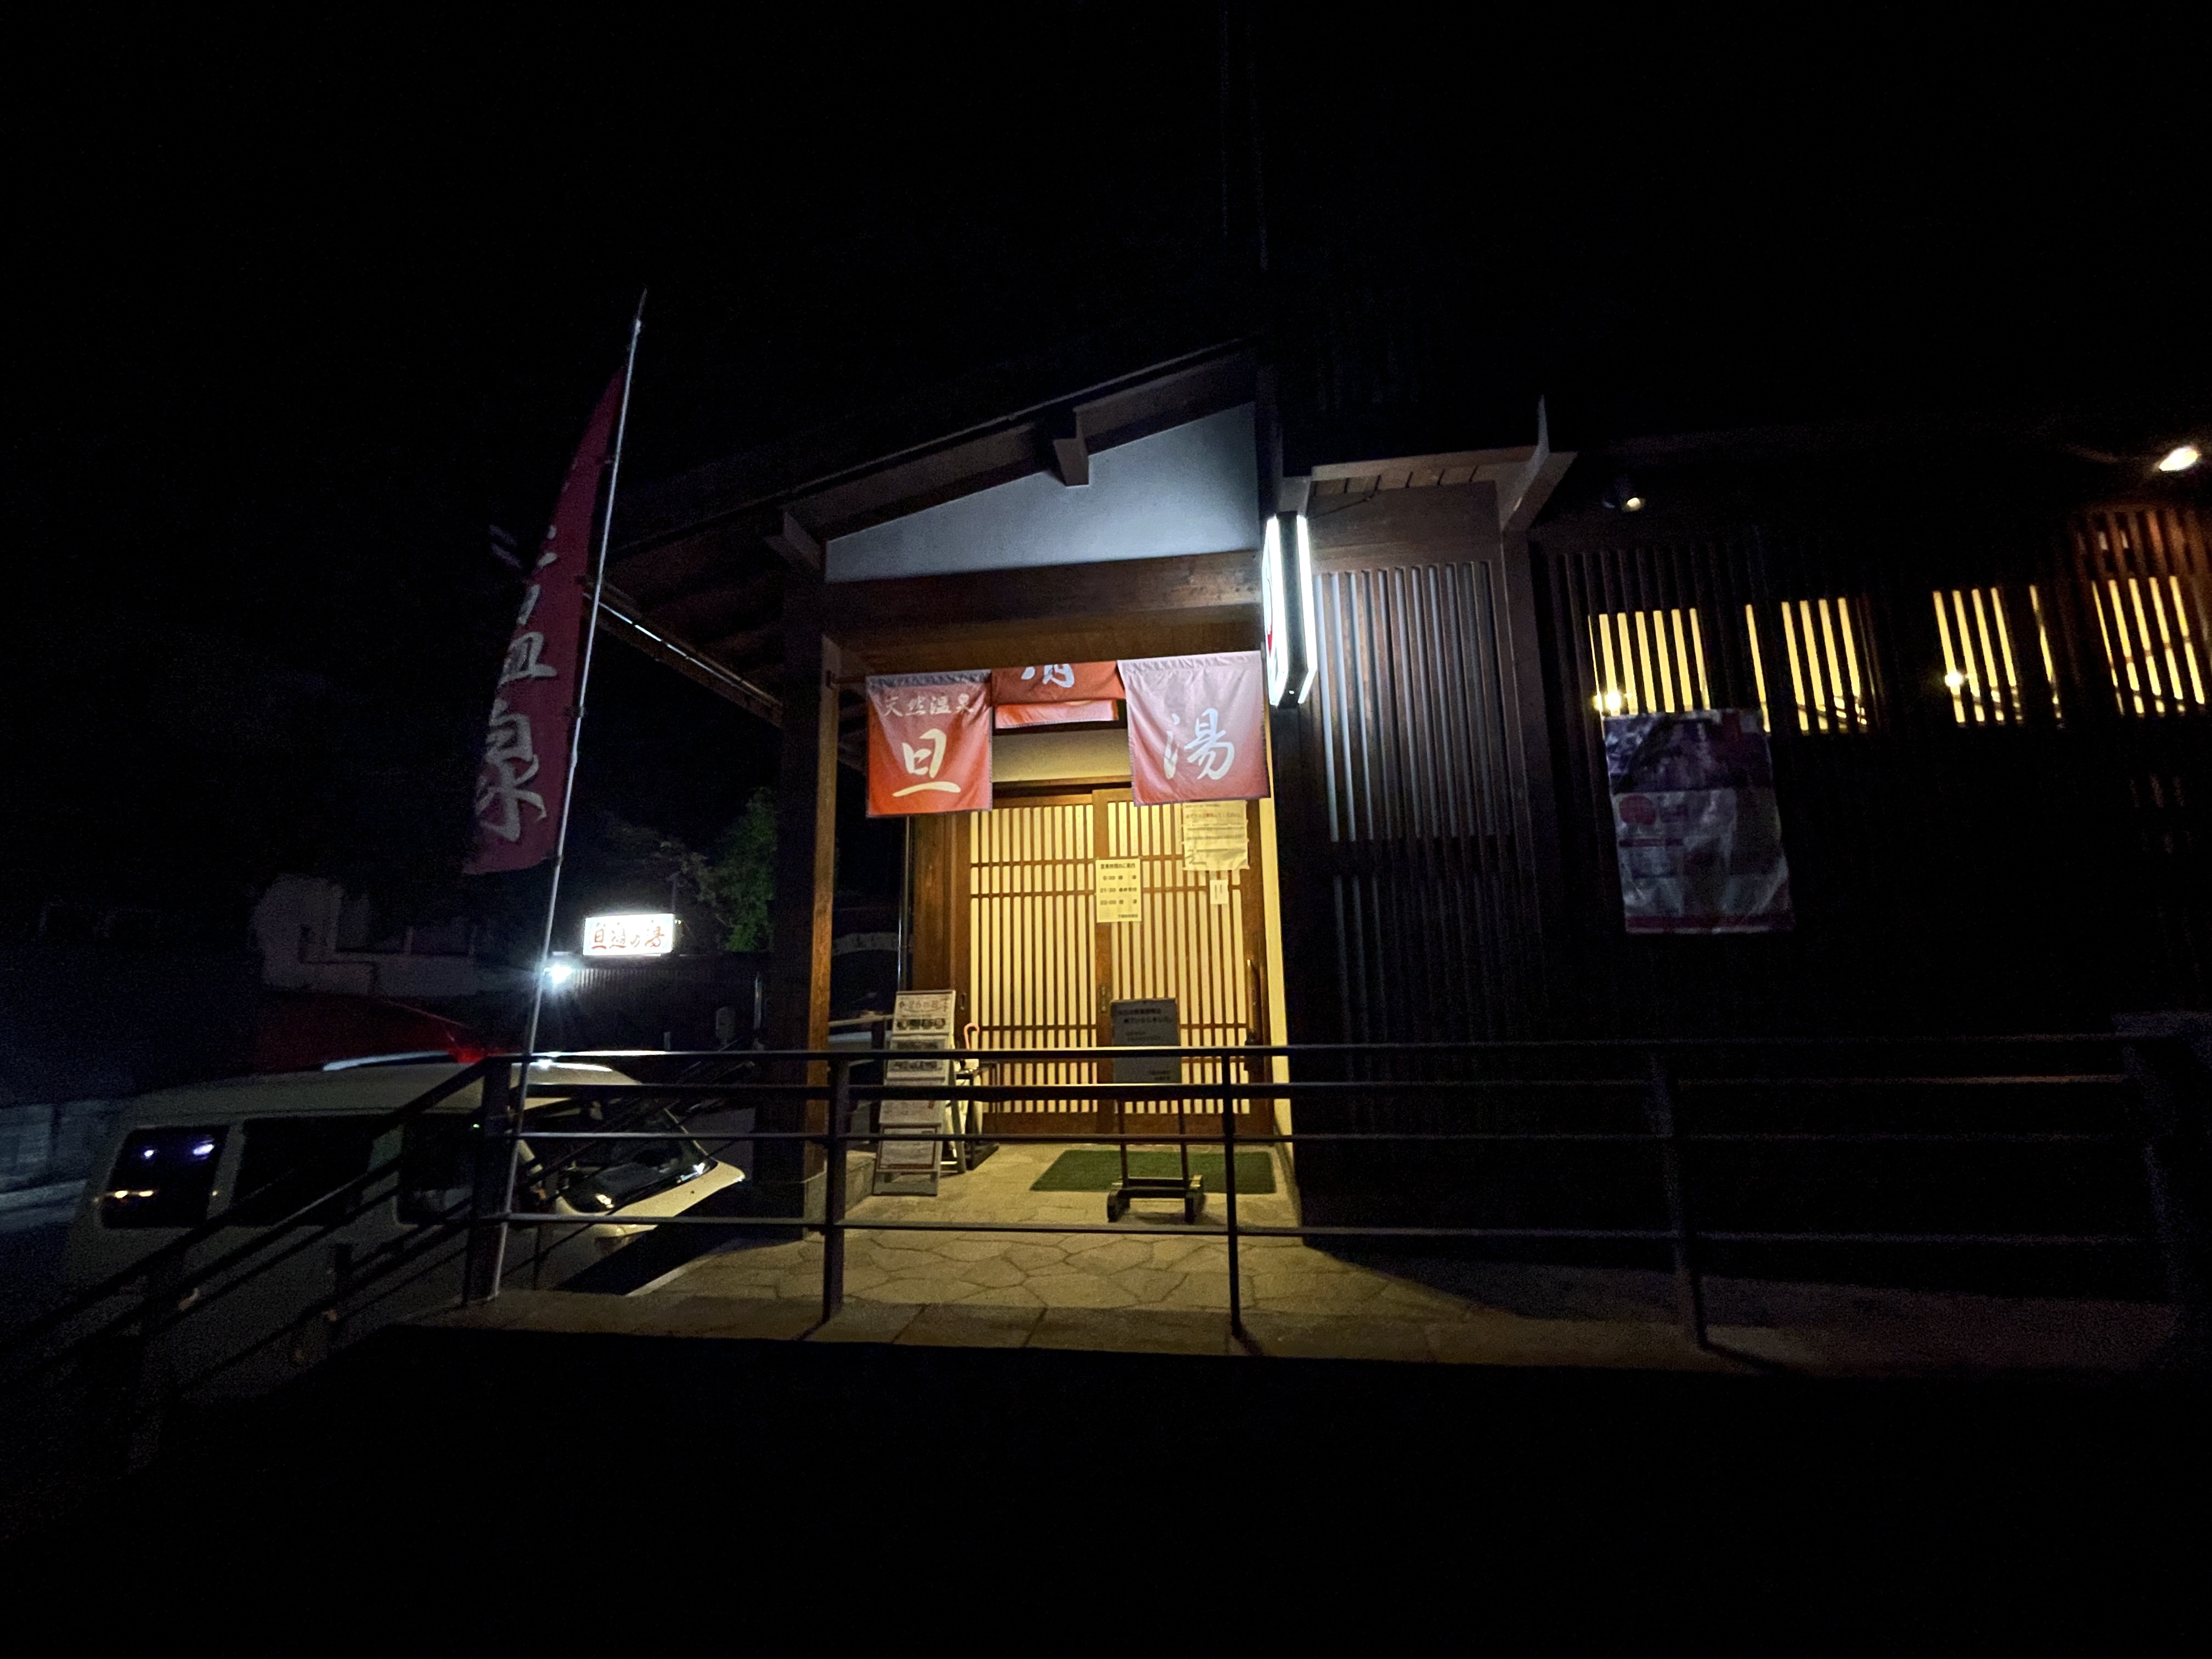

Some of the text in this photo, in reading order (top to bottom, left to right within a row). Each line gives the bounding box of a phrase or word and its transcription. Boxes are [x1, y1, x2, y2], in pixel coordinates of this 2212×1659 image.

[884, 693, 974, 716] 天然温泉
[892, 728, 962, 797] 旦
[1163, 708, 1235, 781] 湯
